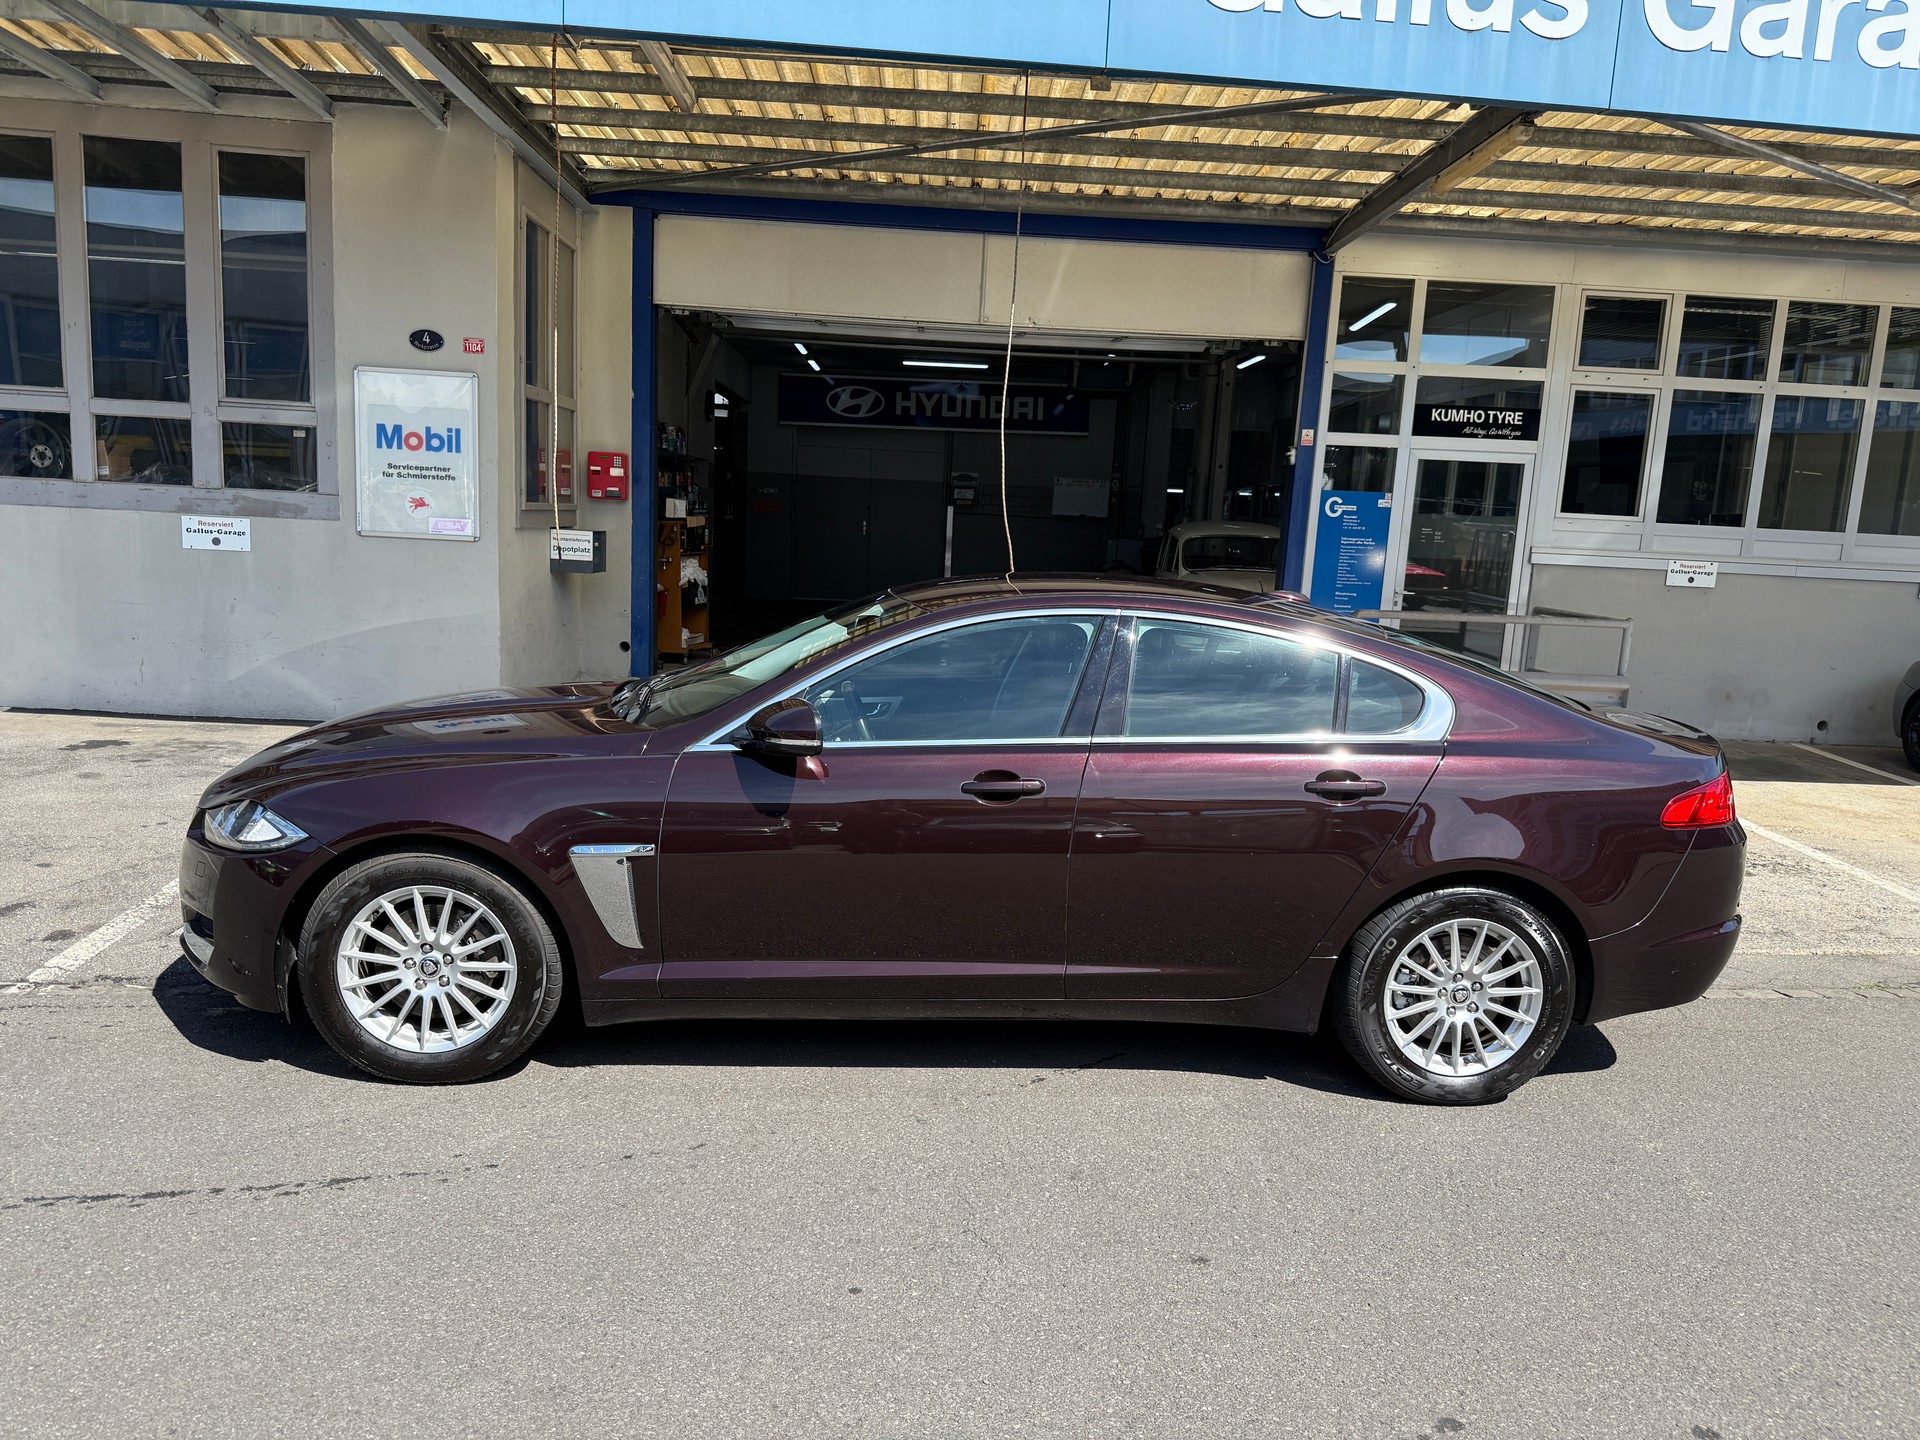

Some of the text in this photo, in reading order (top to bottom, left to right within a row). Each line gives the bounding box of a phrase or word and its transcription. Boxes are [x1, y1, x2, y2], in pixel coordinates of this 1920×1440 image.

[422, 331, 431, 344] 4
[465, 343, 481, 352] 1104
[895, 392, 1044, 420] HYUNDAI
[1431, 408, 1523, 424] KUMHO TYRE
[376, 423, 462, 454] Mobil
[387, 462, 451, 473] Servicepartner
[382, 471, 456, 482] für Schmierstoffe
[186, 527, 246, 536] Gallus-Garage
